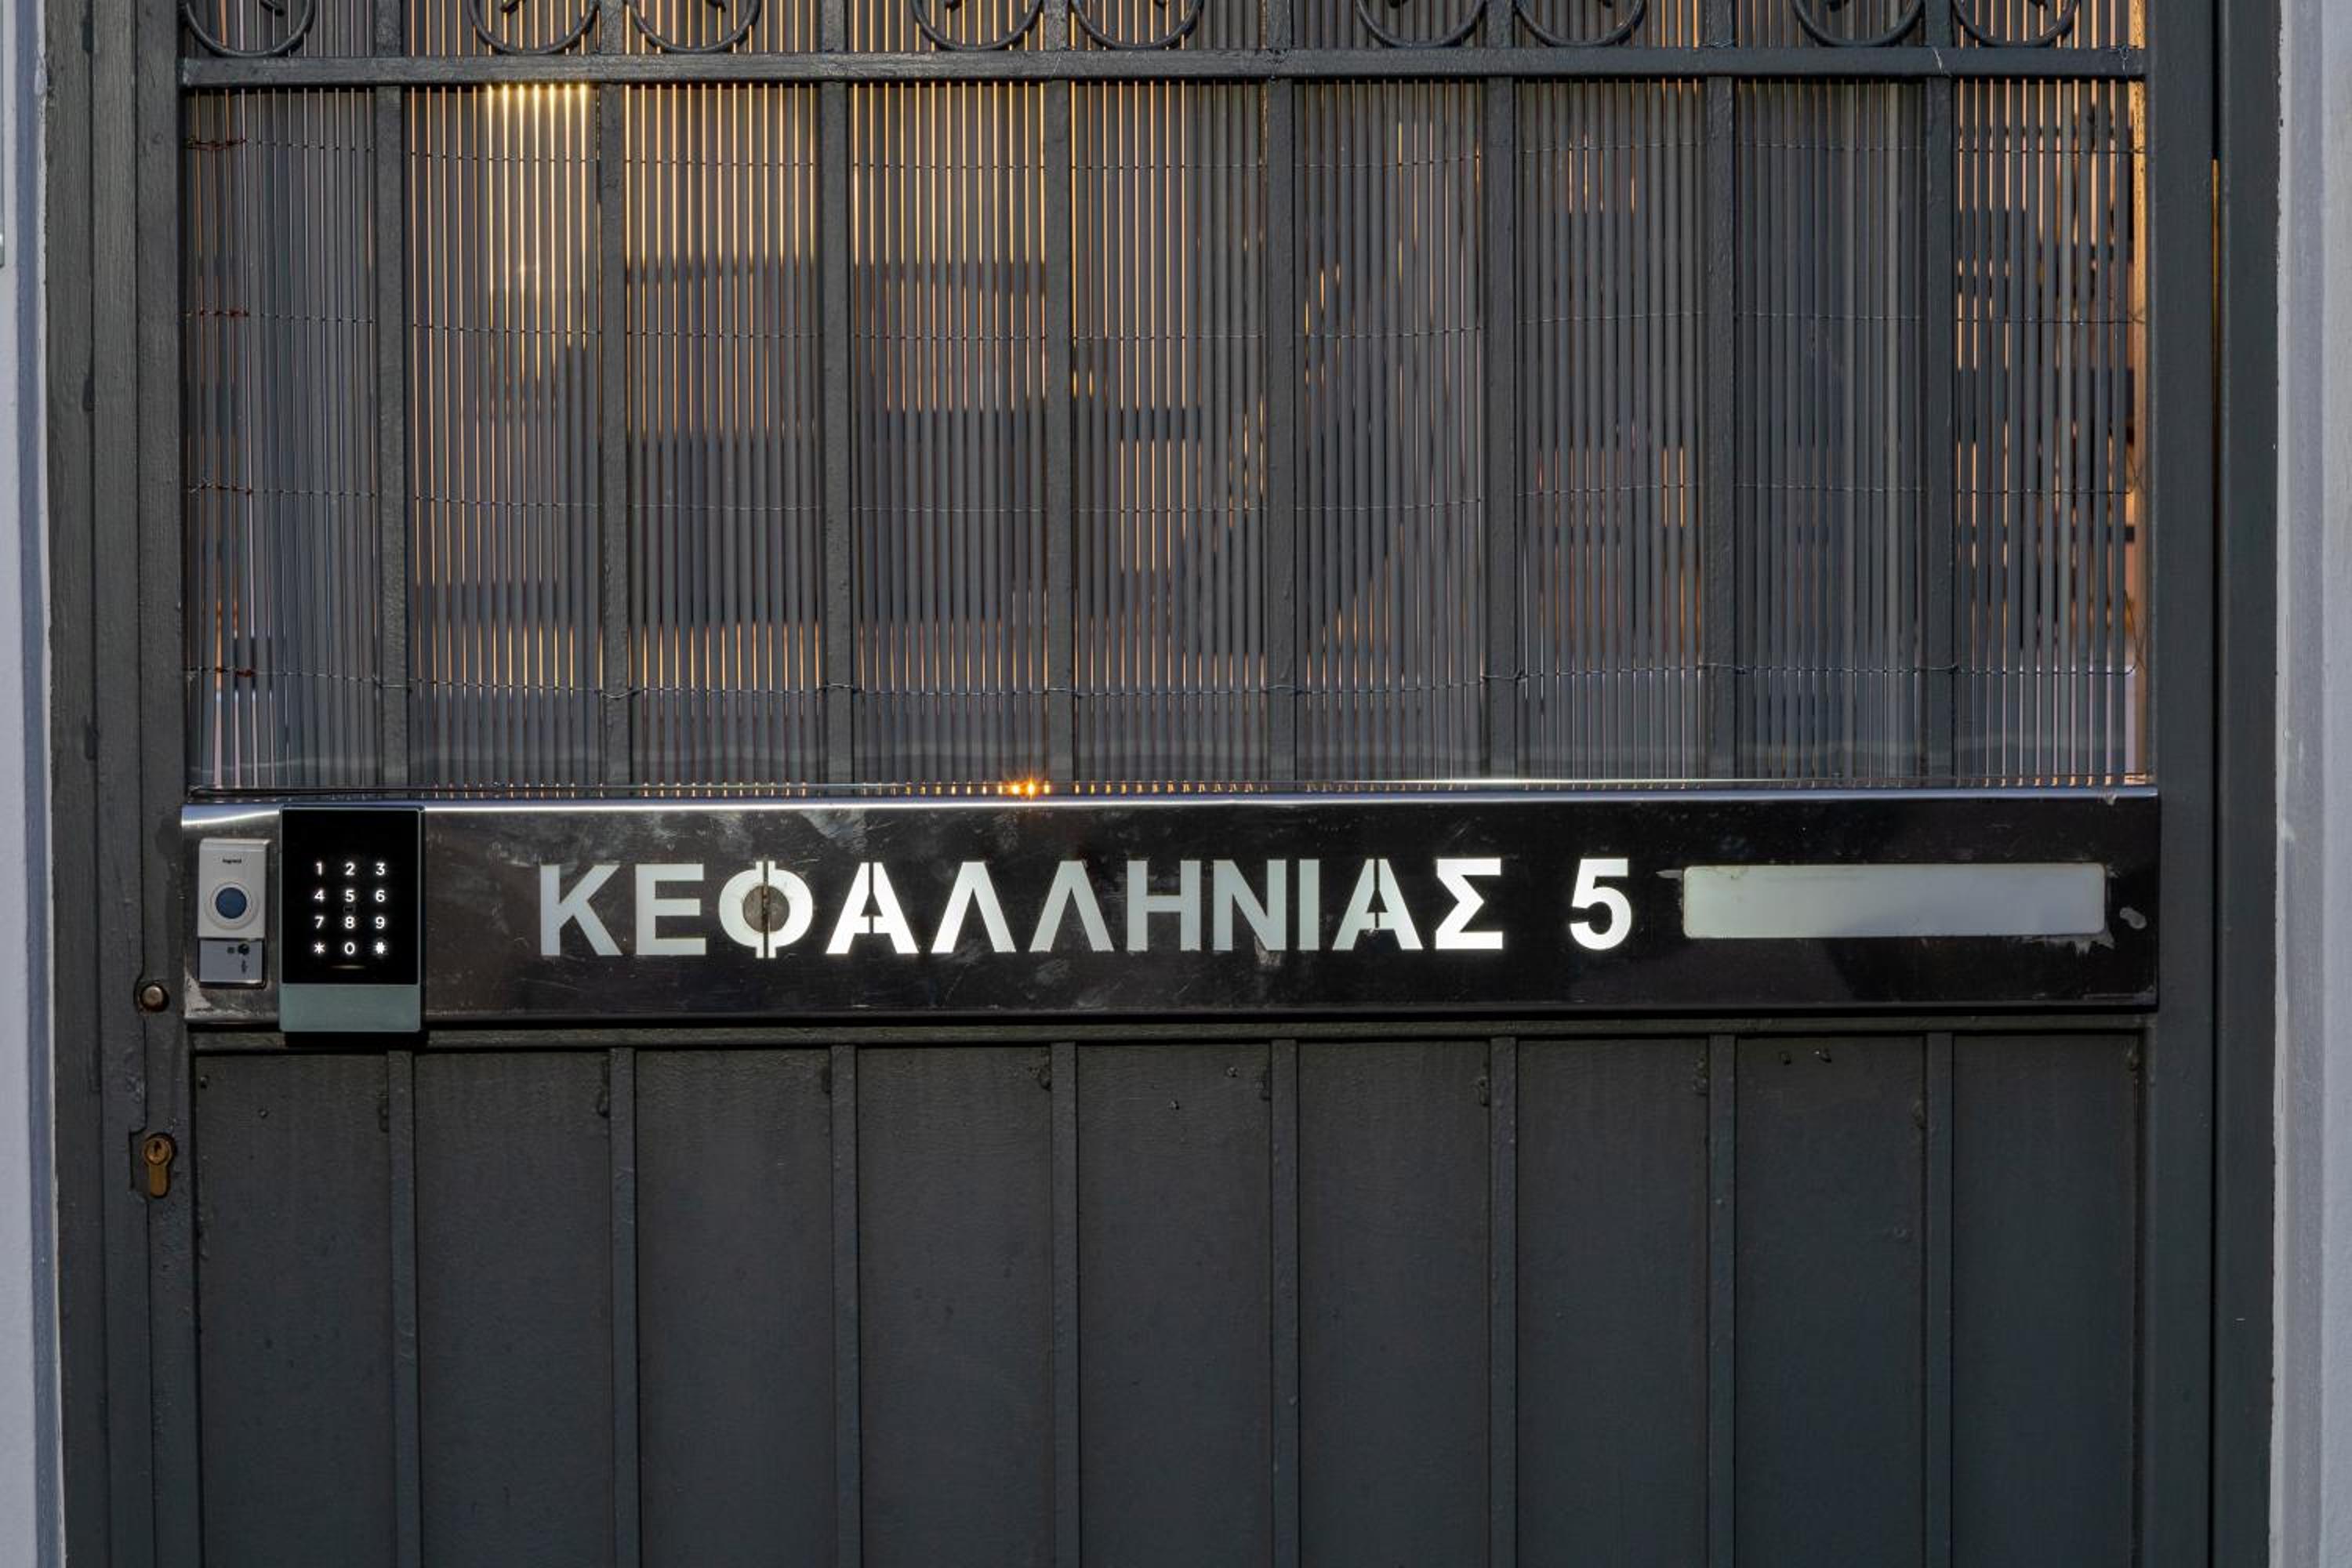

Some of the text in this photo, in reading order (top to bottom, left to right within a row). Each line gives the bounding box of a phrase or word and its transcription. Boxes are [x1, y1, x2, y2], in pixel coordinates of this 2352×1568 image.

[316, 862, 386, 877] 1 2 3
[314, 888, 386, 902] 4 5 6
[539, 858, 1632, 958] ΚΕΦΑΛΛΗΝΙΑΣ 5
[314, 915, 386, 929] 7 8 9
[343, 942, 356, 955] 0
